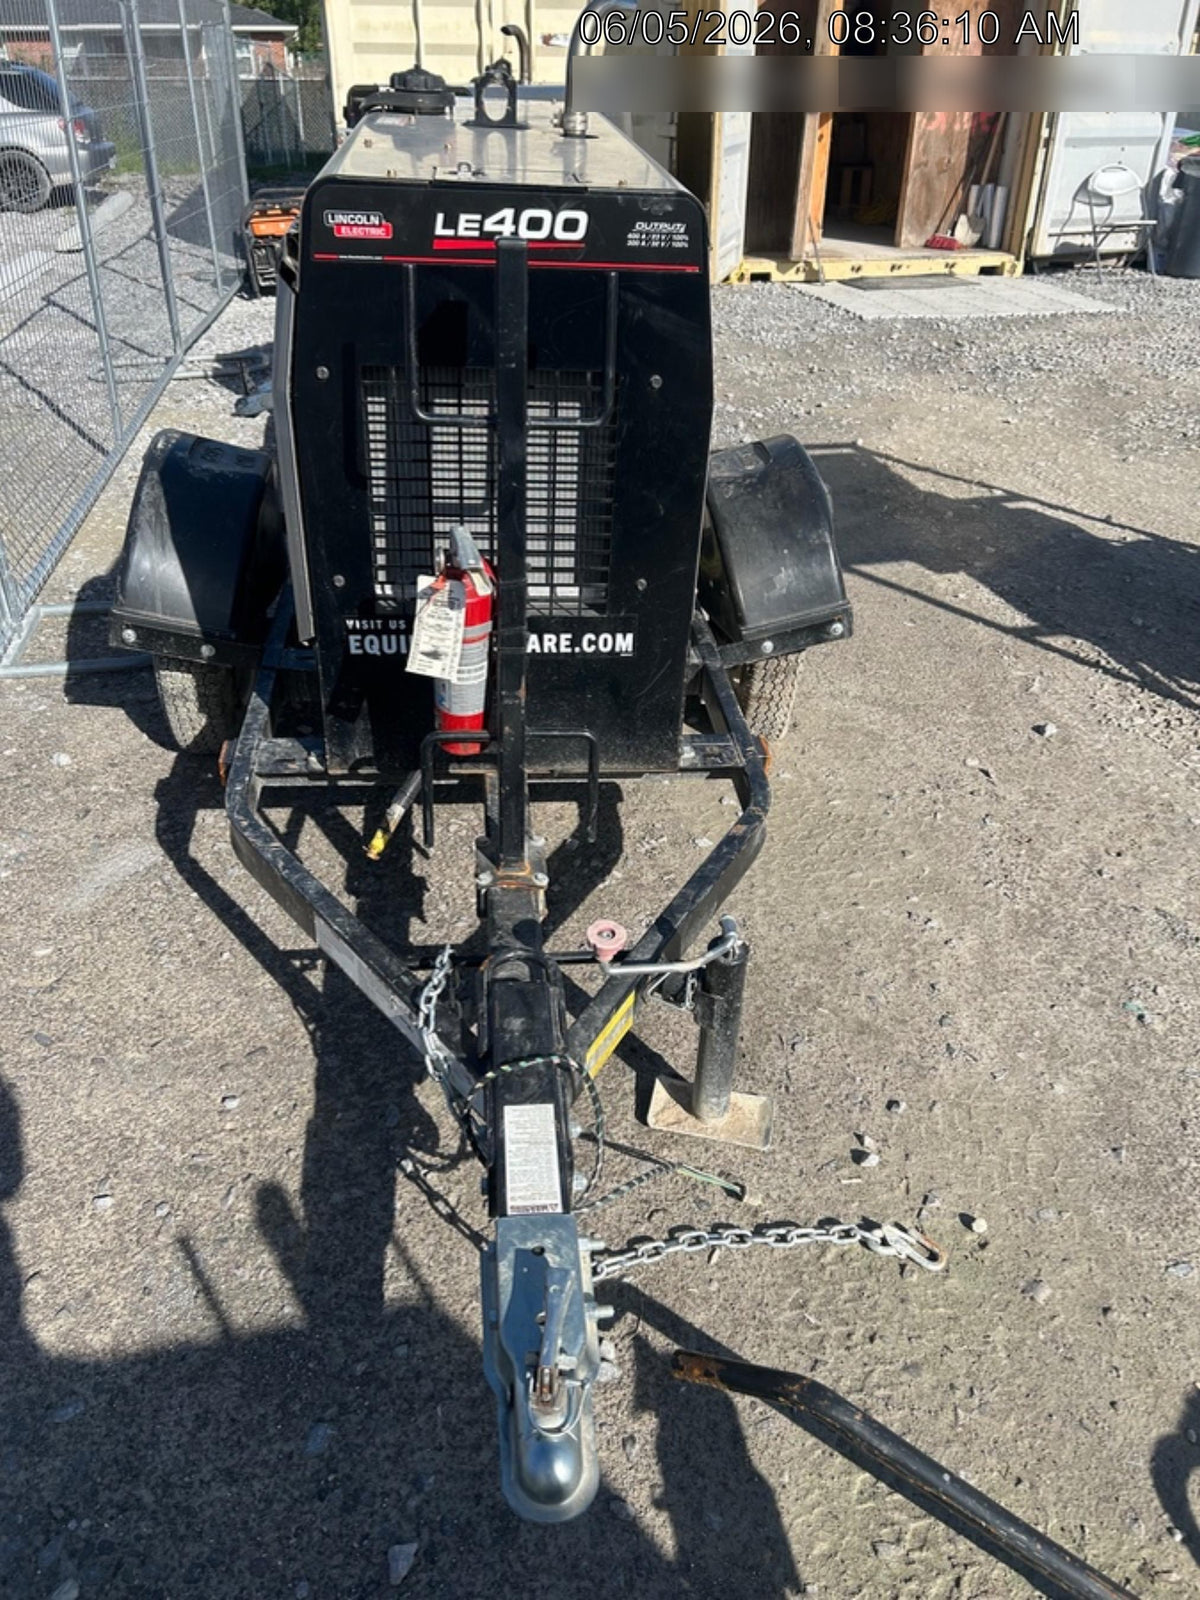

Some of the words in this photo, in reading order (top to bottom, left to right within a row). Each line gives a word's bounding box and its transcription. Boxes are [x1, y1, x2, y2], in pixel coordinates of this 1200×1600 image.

[328, 213, 380, 225] LINCOLN
[434, 208, 589, 240] LE400
[341, 225, 387, 236] ELECTRIC
[634, 221, 685, 230] OUTPUT
[346, 619, 383, 630] VISIT
[389, 619, 407, 630] US
